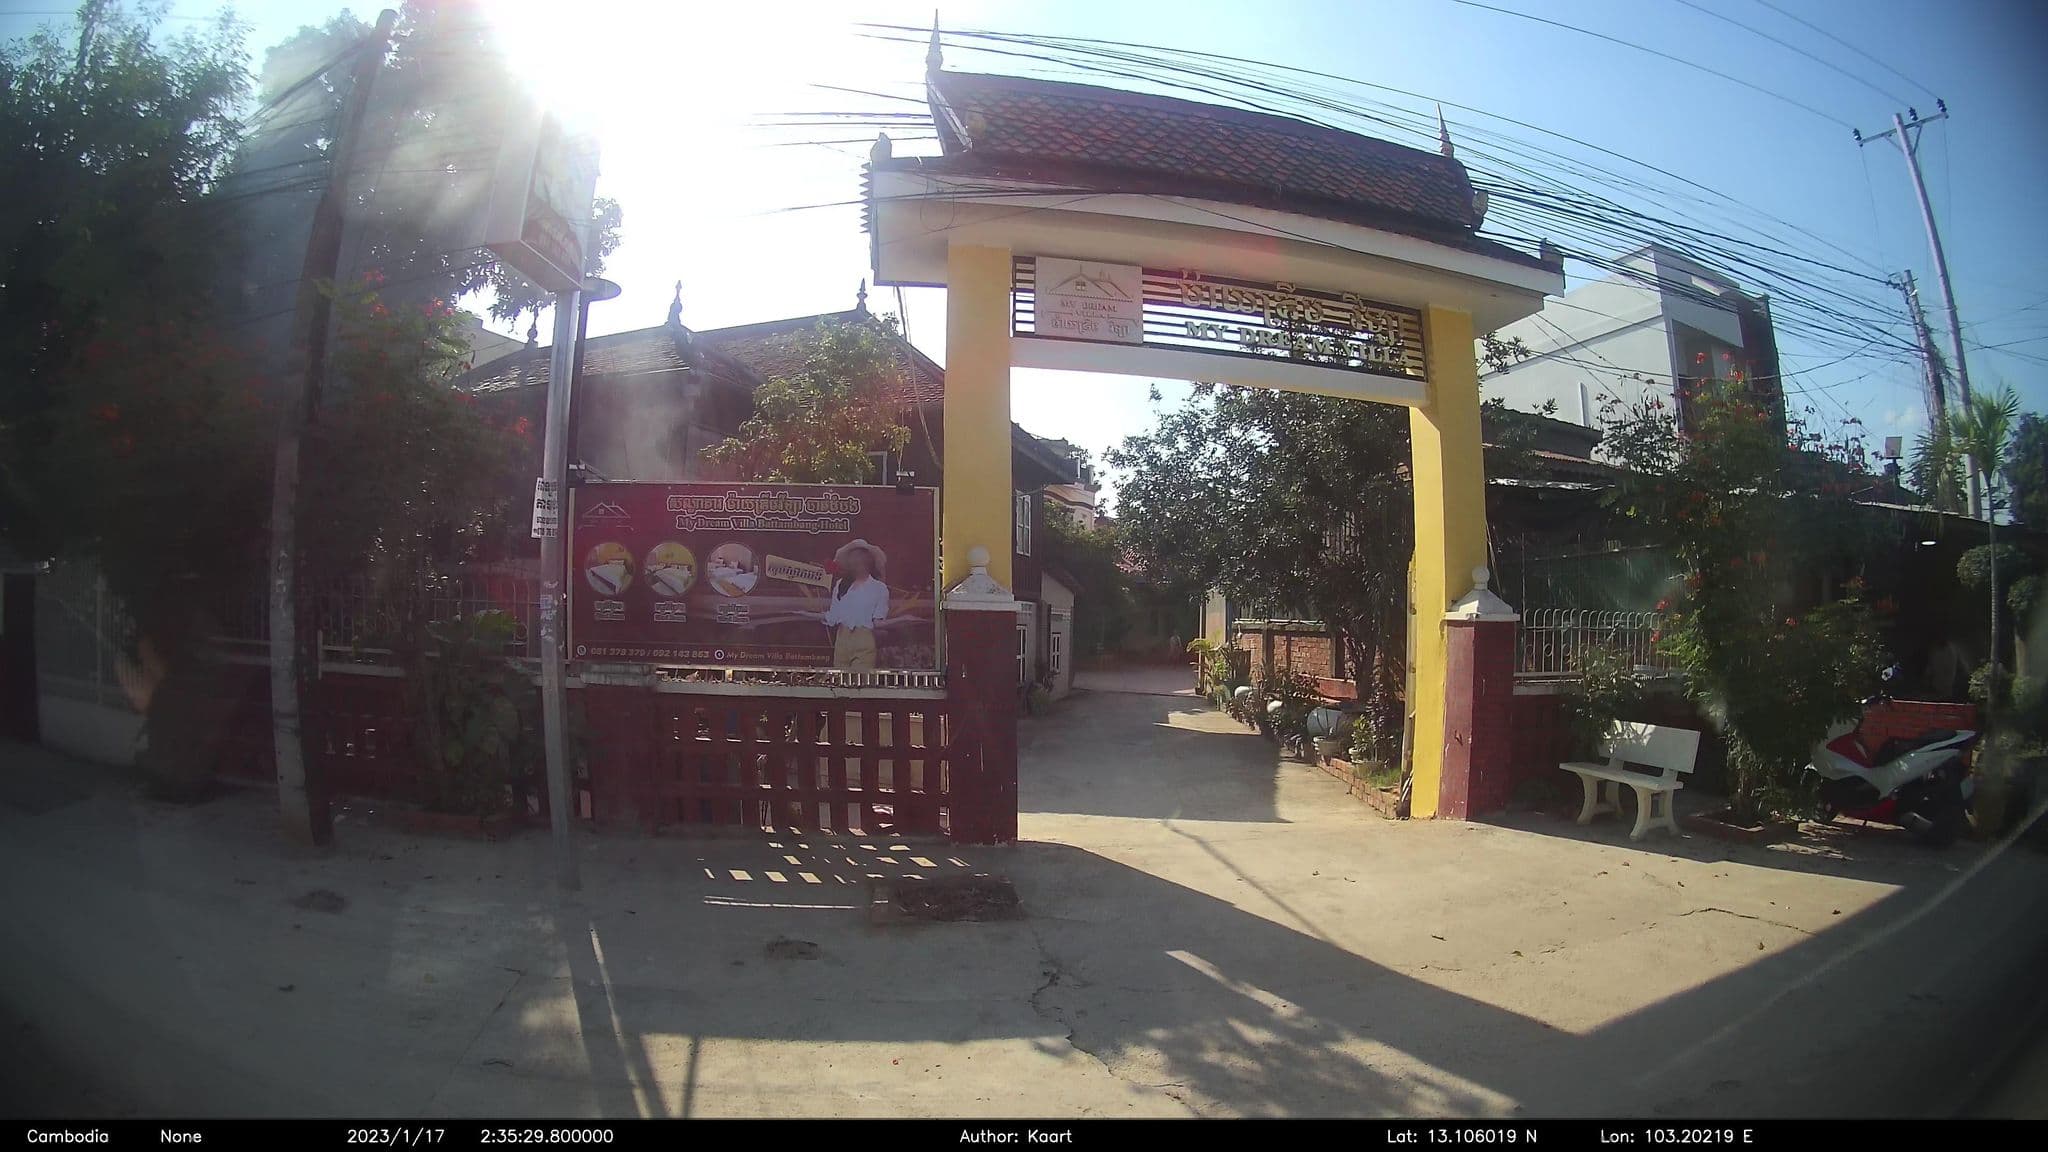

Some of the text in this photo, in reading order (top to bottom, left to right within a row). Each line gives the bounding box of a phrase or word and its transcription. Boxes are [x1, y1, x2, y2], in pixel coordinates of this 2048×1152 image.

[1081, 302, 1118, 313] DREAM
[1185, 321, 1411, 366] MY DREAM VILLA
[677, 516, 848, 532] My Dream Villa Battambang Hotel
[740, 651, 764, 660] Dream
